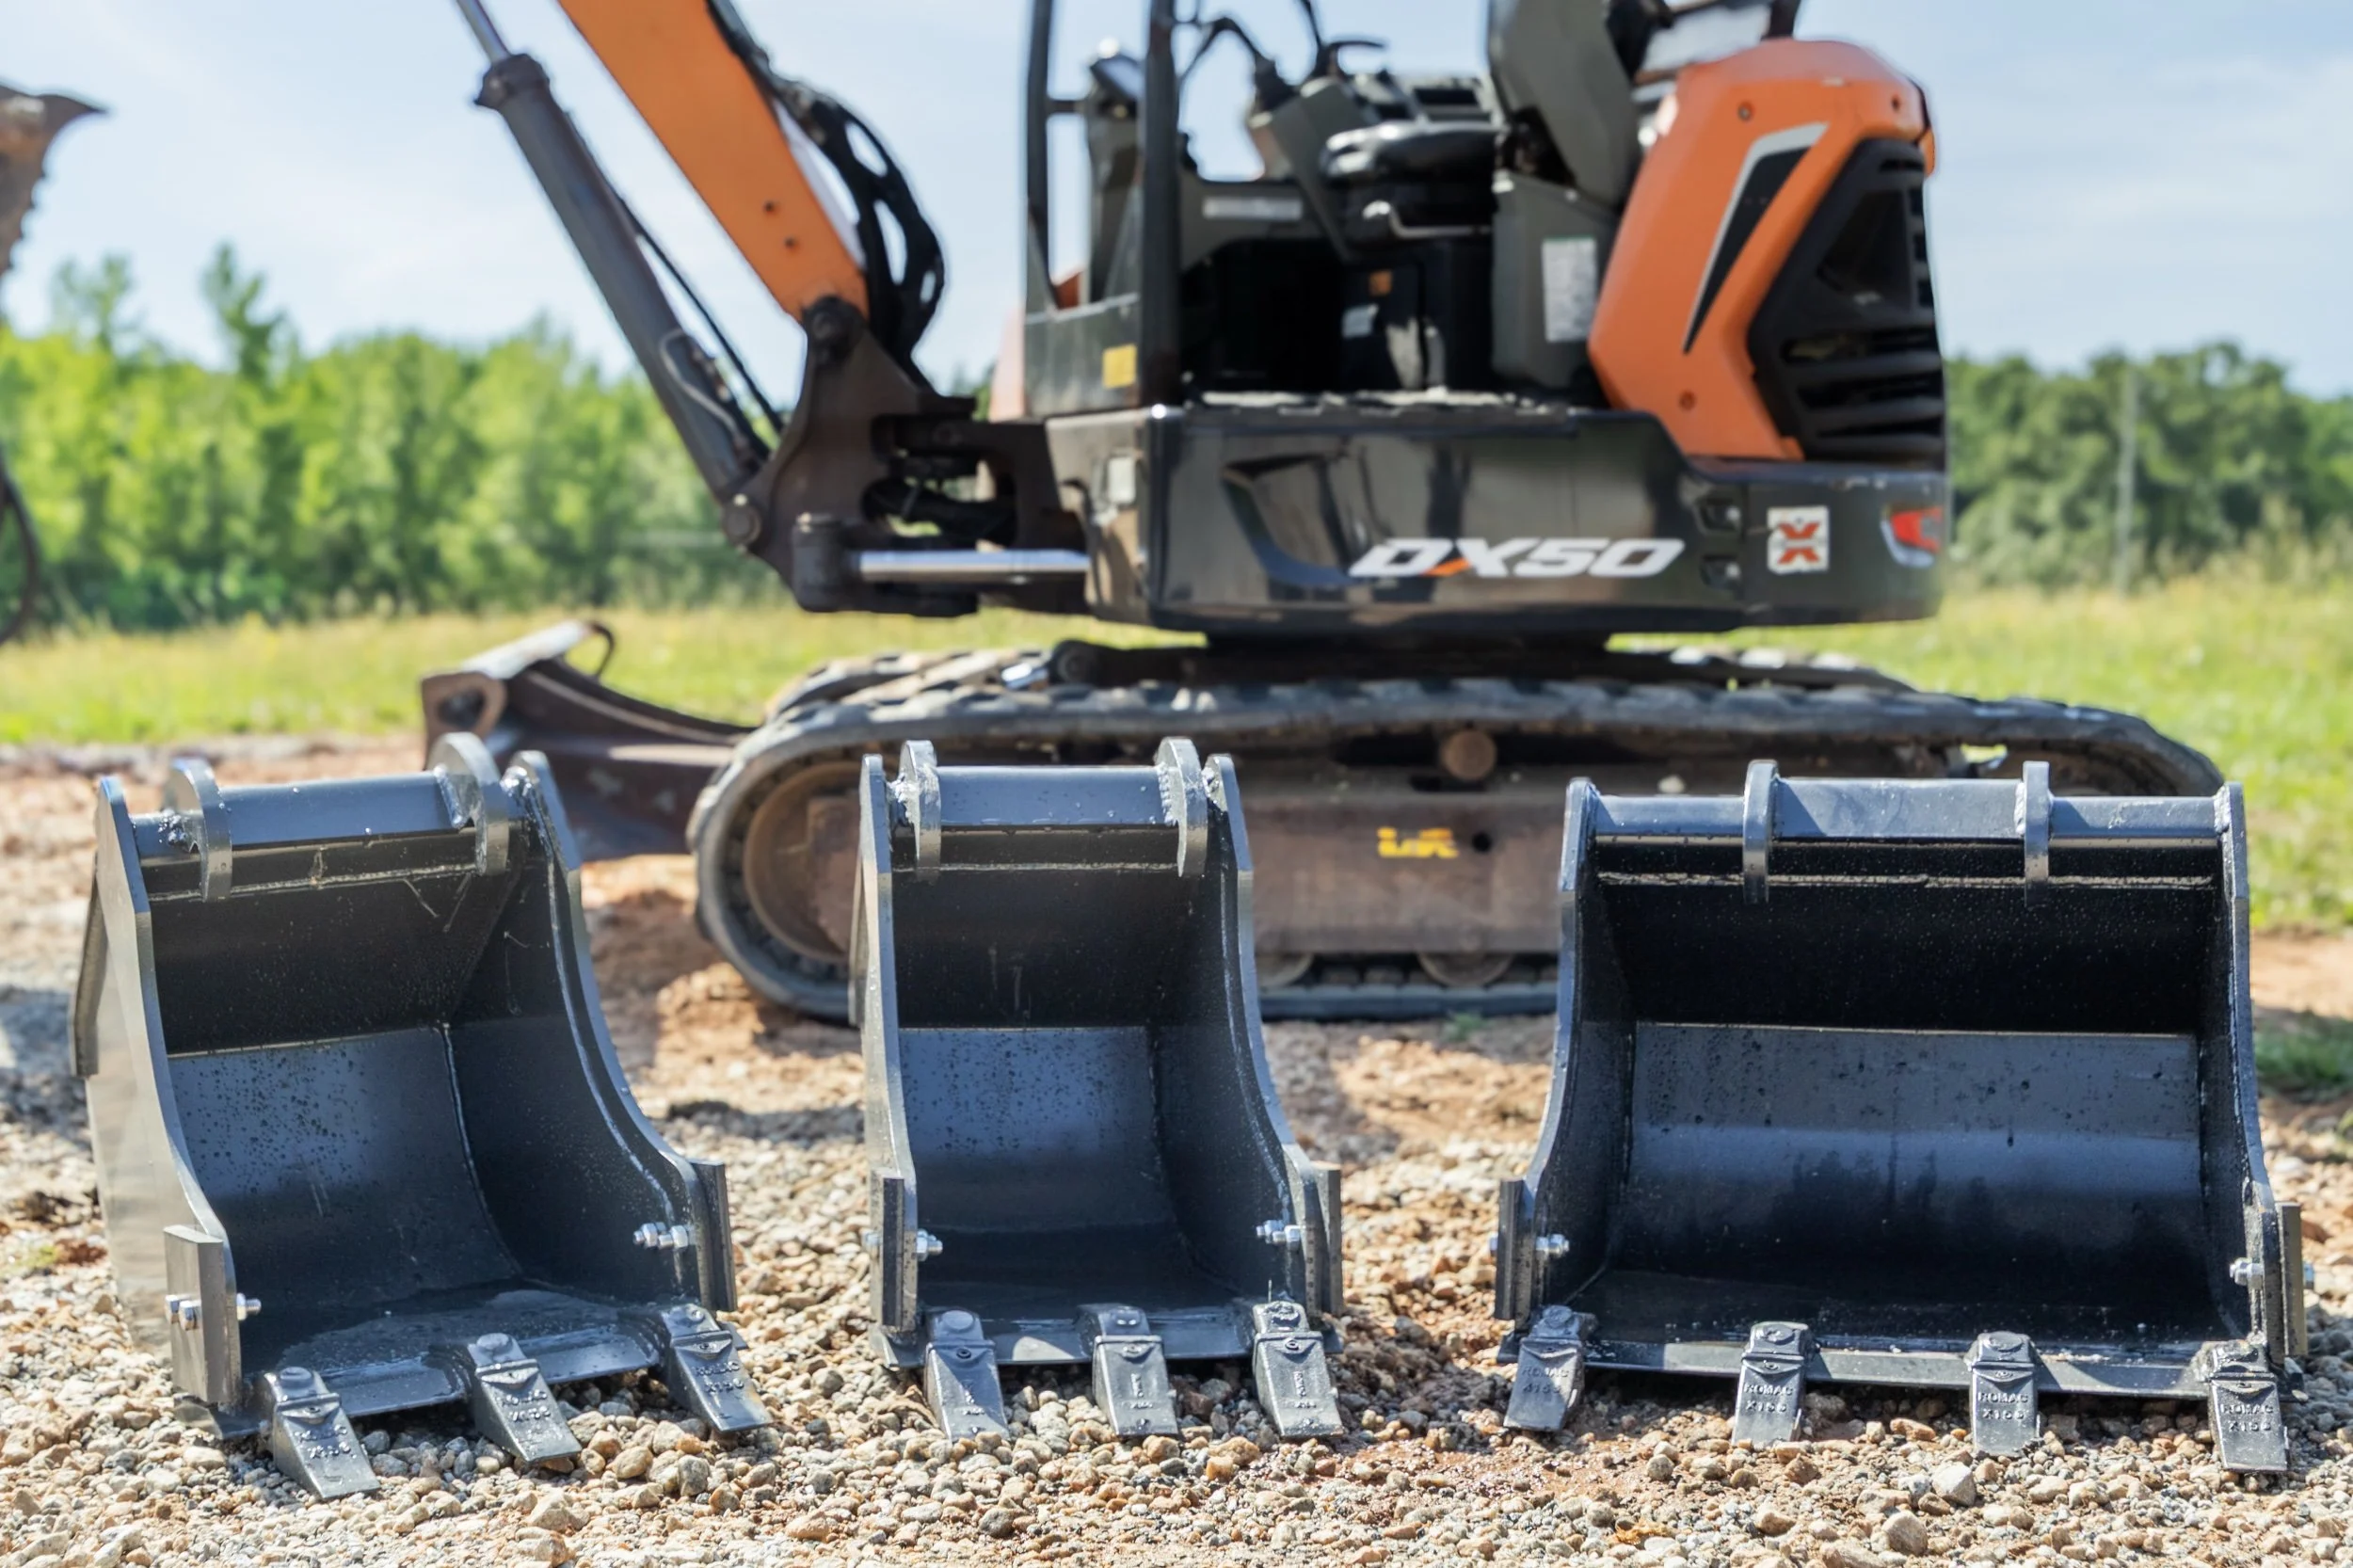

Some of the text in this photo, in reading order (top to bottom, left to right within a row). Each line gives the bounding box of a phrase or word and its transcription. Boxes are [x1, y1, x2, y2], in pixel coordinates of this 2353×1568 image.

[1348, 536, 1686, 579] DX50
[1744, 1384, 1794, 1396] ROMAC
[1977, 1392, 2029, 1404] ROMAC
[2220, 1403, 2274, 1415] ROMAC
